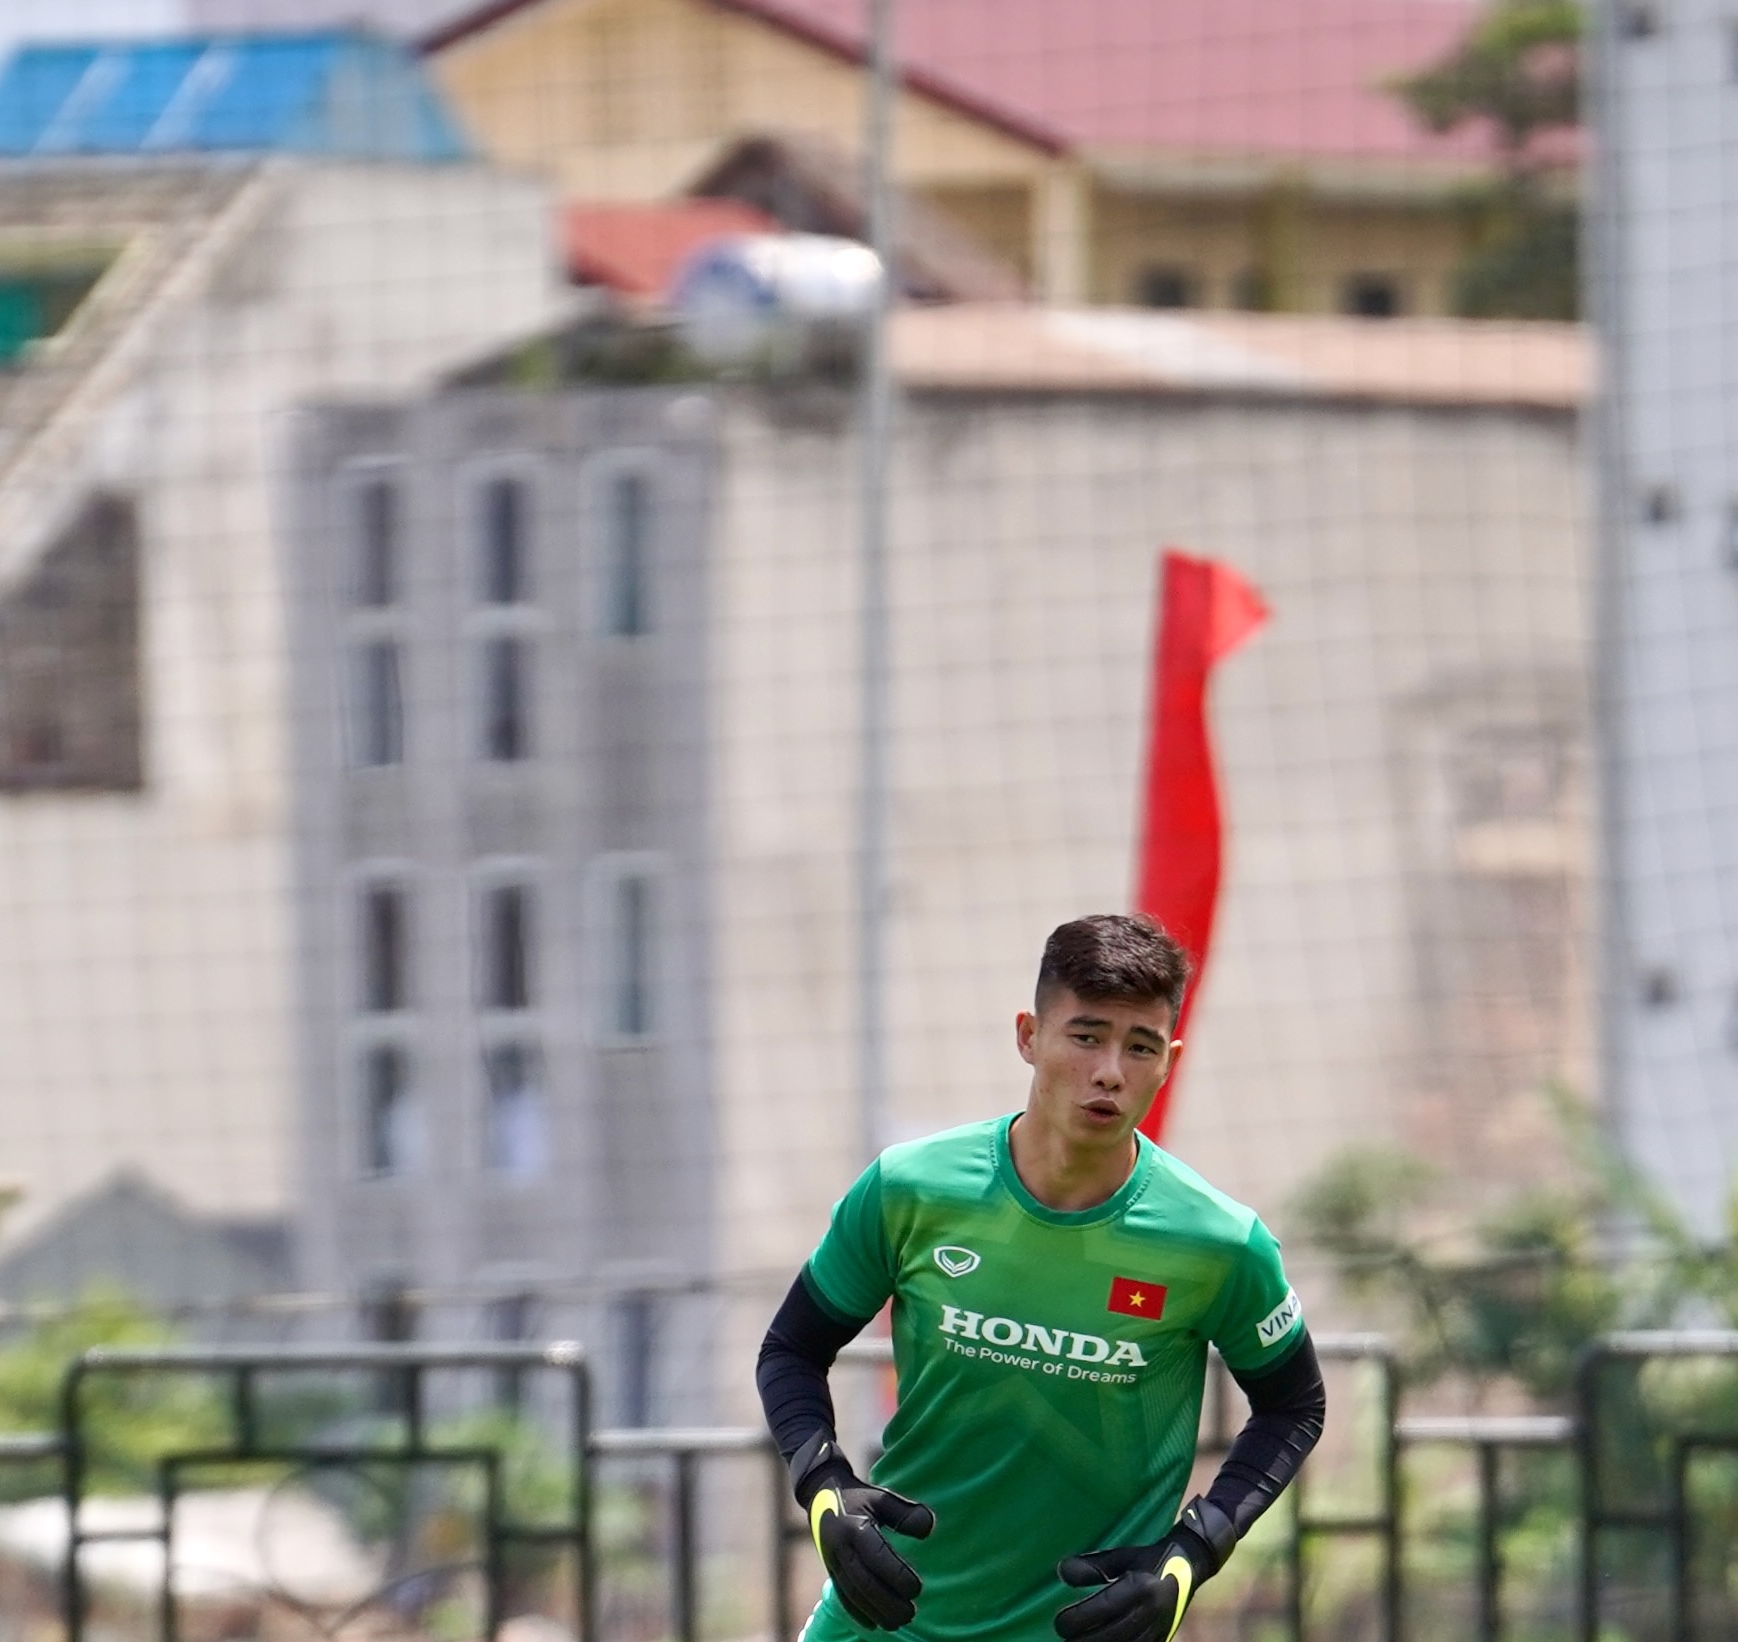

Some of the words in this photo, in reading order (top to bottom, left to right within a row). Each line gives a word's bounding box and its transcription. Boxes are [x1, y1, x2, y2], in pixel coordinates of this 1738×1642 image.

[938, 1304, 1148, 1367] HONDA
[943, 1336, 976, 1358] The
[978, 1346, 1040, 1370] Power
[1042, 1362, 1063, 1376] of
[1067, 1364, 1137, 1385] Dreams
